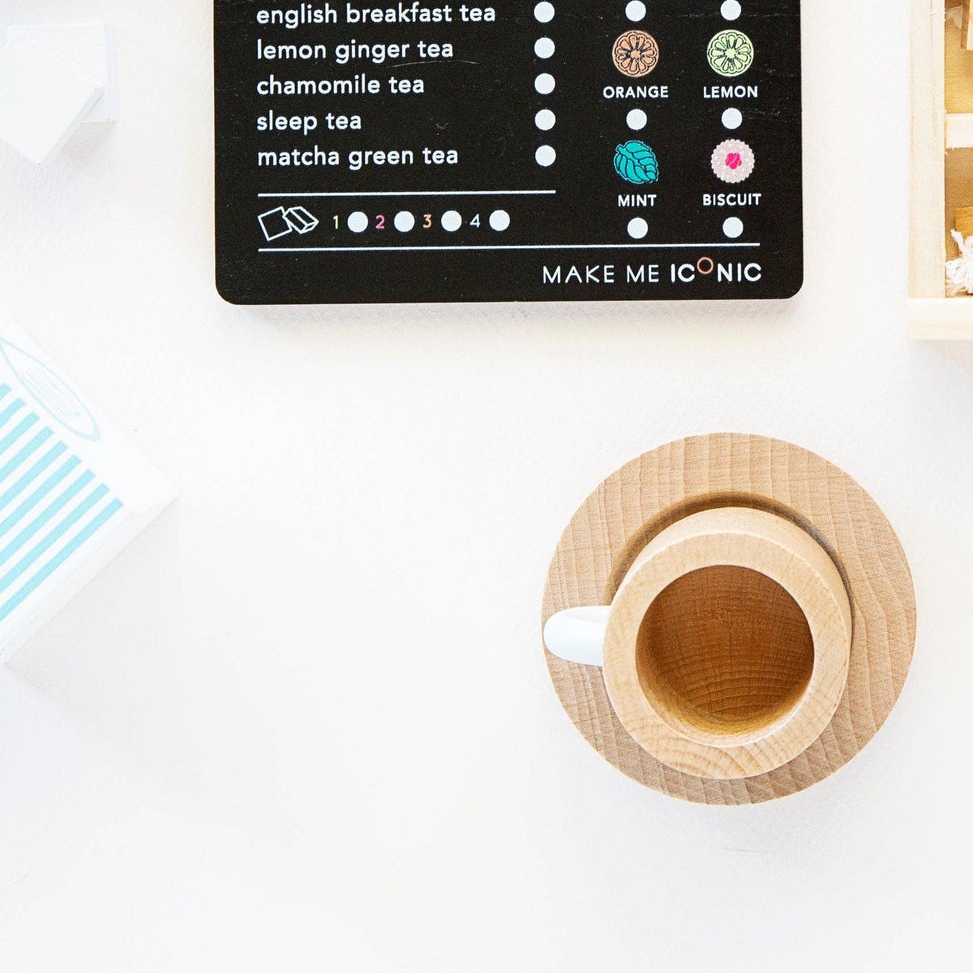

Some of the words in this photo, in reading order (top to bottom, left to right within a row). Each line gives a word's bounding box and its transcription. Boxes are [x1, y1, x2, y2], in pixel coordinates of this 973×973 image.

[256, 2, 338, 29] english
[346, 0, 453, 24] breakfast
[458, 4, 496, 22] tea
[257, 38, 327, 60] lemon
[334, 38, 411, 65] ginger
[416, 40, 454, 58] tea
[256, 72, 381, 96] chamomile
[388, 76, 425, 94] tea
[602, 85, 669, 99] ORANGE
[703, 85, 758, 99] LEMON
[256, 109, 318, 135] sleep
[325, 112, 362, 130] tea
[257, 144, 340, 167] matcha
[348, 150, 414, 171] green
[421, 147, 459, 165] tea
[617, 193, 657, 207] MINT
[702, 192, 762, 207] BISCUIT
[332, 214, 339, 230] 1
[375, 214, 385, 230] 2
[422, 213, 432, 229] 3
[469, 213, 481, 228] 4
[542, 264, 615, 284] MAKE
[626, 264, 660, 283] ME
[670, 256, 762, 283] ICONIC
